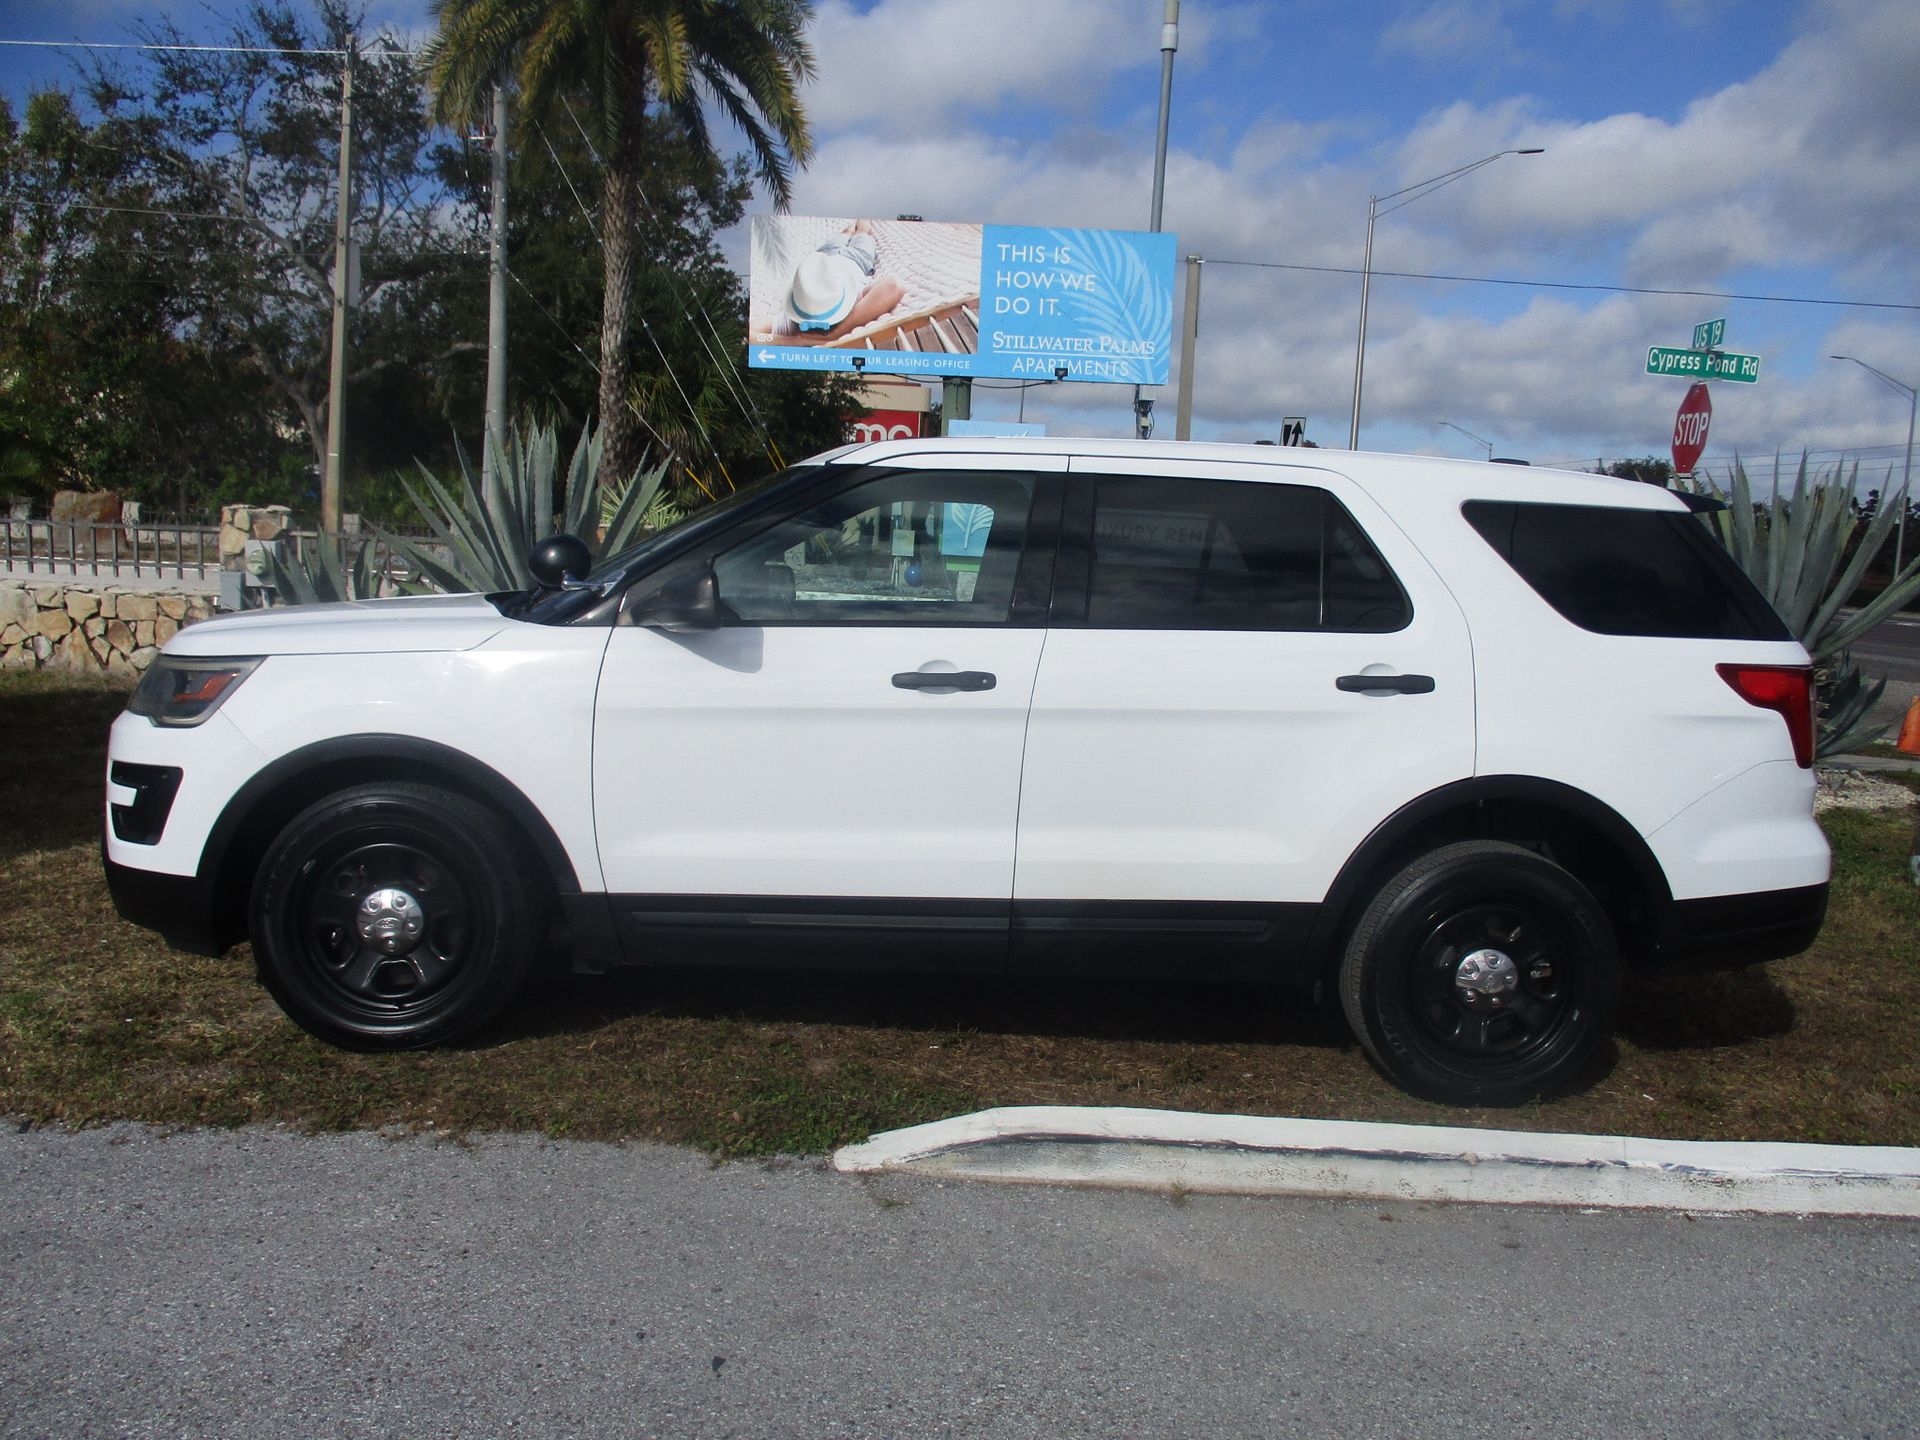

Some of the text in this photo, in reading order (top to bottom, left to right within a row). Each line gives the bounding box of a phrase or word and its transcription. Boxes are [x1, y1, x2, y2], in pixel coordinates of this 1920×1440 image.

[997, 244, 1071, 264] THIS IS
[996, 270, 1096, 292] HOW WE
[995, 297, 1061, 316] DO IT.
[992, 331, 1156, 355] STILLWATER PALMS
[1694, 321, 1722, 348] US 19
[781, 353, 809, 363] TURN
[814, 354, 836, 364] LEFT
[864, 356, 882, 365] UR
[886, 357, 930, 368] LEASING
[934, 359, 971, 369] OFFICE
[1011, 357, 1129, 377] APARTMENTS
[1649, 349, 1759, 376] Cypress Pond Rd
[1674, 412, 1709, 447] STOP
